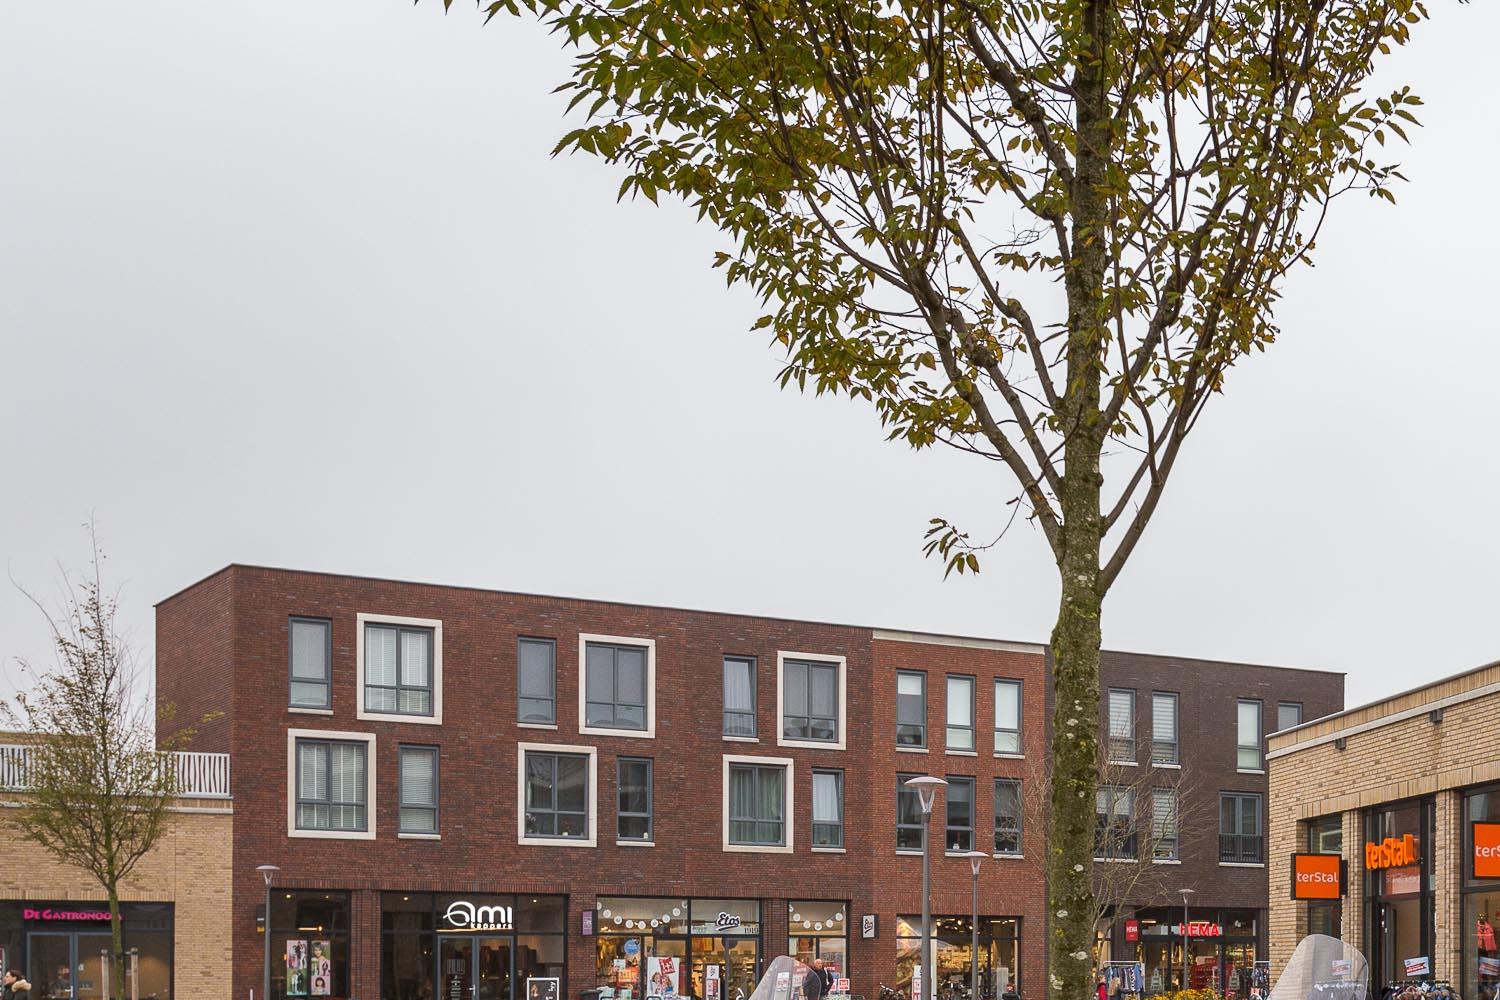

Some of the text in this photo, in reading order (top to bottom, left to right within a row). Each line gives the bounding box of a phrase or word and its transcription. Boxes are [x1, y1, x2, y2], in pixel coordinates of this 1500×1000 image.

[1365, 833, 1415, 869] terStal
[1296, 872, 1339, 883] terStal
[716, 911, 741, 930] Etos
[1179, 922, 1220, 937] HEMA
